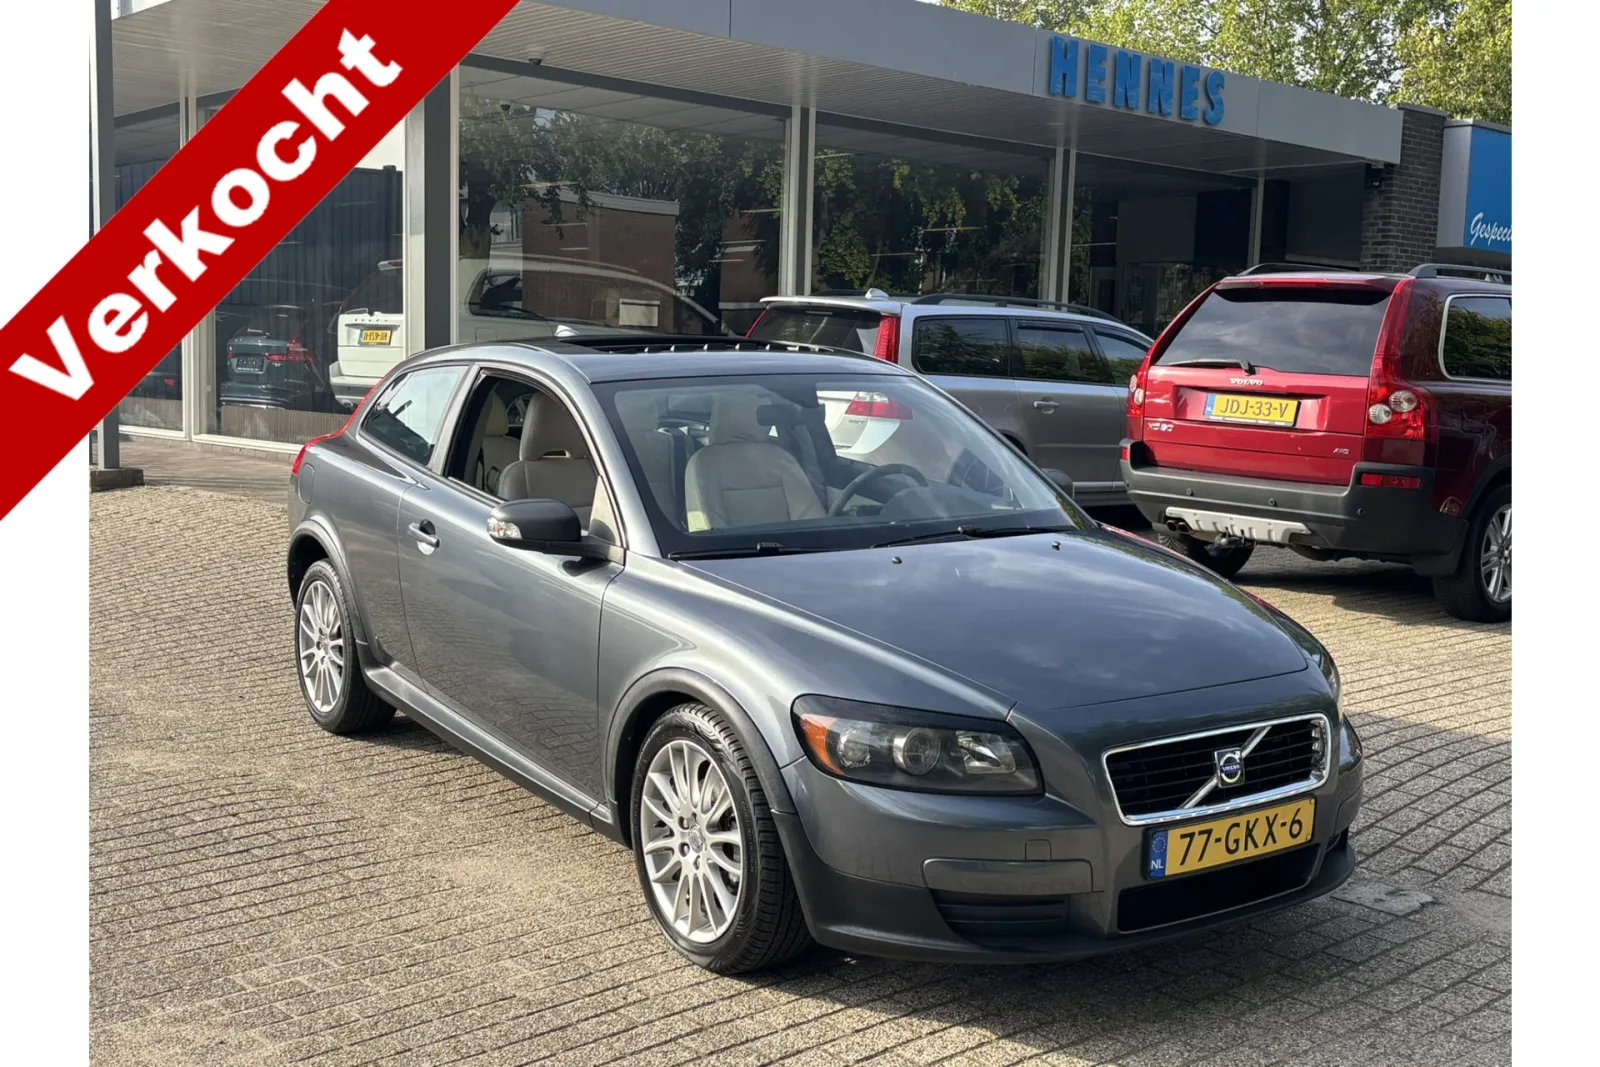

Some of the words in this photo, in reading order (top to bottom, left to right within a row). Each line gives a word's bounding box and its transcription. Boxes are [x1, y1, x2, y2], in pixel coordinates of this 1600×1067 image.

[1050, 35, 1226, 126] HENNES
[1229, 377, 1264, 386] VOLVO
[1220, 398, 1289, 418] JDJ-33-V
[1151, 859, 1164, 869] NL
[1179, 807, 1304, 866] 77-GKX-6
